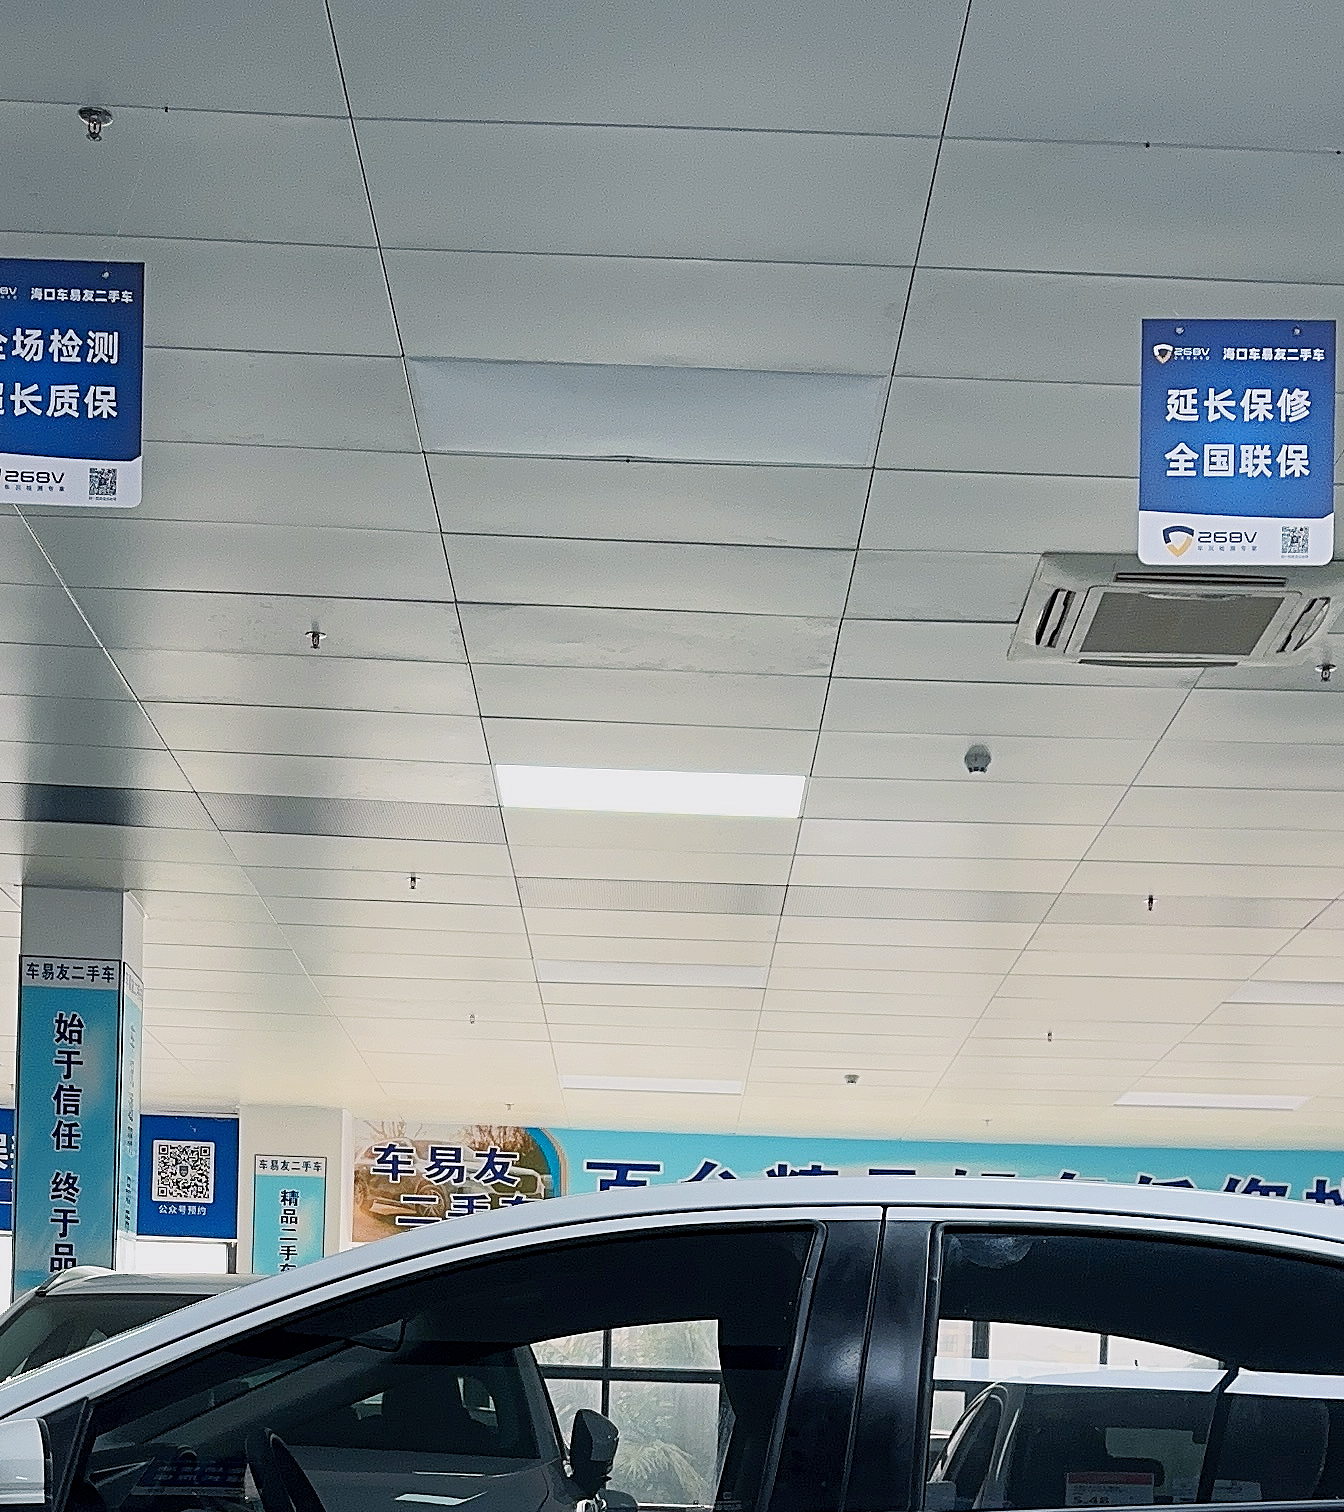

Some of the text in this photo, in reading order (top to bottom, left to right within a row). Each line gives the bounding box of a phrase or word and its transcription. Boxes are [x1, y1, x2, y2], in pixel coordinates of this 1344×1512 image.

[30, 286, 134, 304] 海口车易友二手车
[1222, 347, 1325, 362] 海口车易友二手车
[1164, 387, 1312, 423] 延长保修
[1164, 442, 1311, 478] 全国联保
[4, 470, 65, 484] 268V
[1197, 531, 1258, 543] 268V
[25, 961, 116, 984] 车易友二手车
[51, 1011, 85, 1152] 始于信任
[259, 1159, 323, 1174] 车易友二手车
[371, 1143, 520, 1185] 车易友
[158, 1204, 208, 1217] 公众号预约
[396, 1195, 534, 1226] 二手
